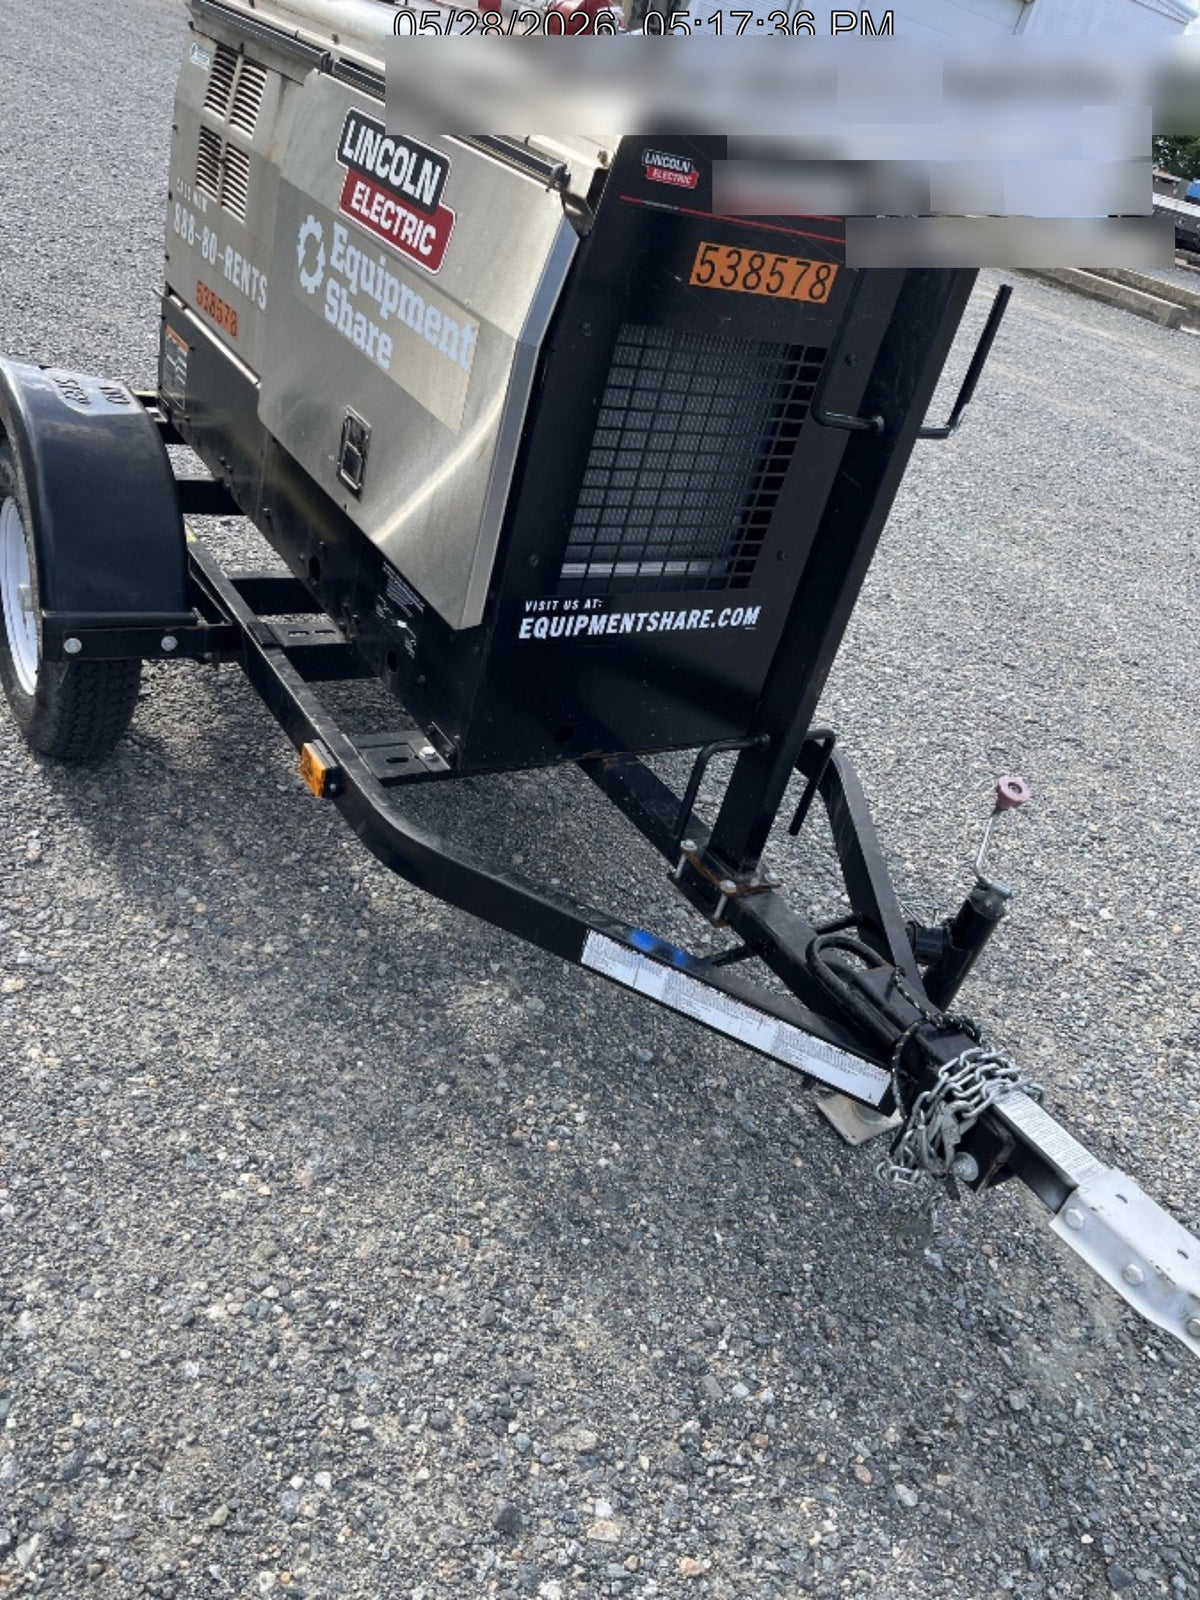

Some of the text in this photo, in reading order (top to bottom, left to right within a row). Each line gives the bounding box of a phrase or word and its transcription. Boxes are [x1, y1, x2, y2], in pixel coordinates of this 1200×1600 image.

[342, 119, 442, 207] LINCOLN
[644, 152, 691, 173] LINCOLN
[652, 168, 693, 185] ELECTRIC
[350, 180, 437, 256] ELECTRIC
[173, 202, 268, 312] 888-80-RENTS
[695, 244, 832, 301] 538578
[325, 278, 394, 371] Share
[330, 221, 477, 372] Equipment
[518, 605, 762, 640] EQUIPMENTSHARE.COM
[525, 598, 603, 613] VISIT US AT:
